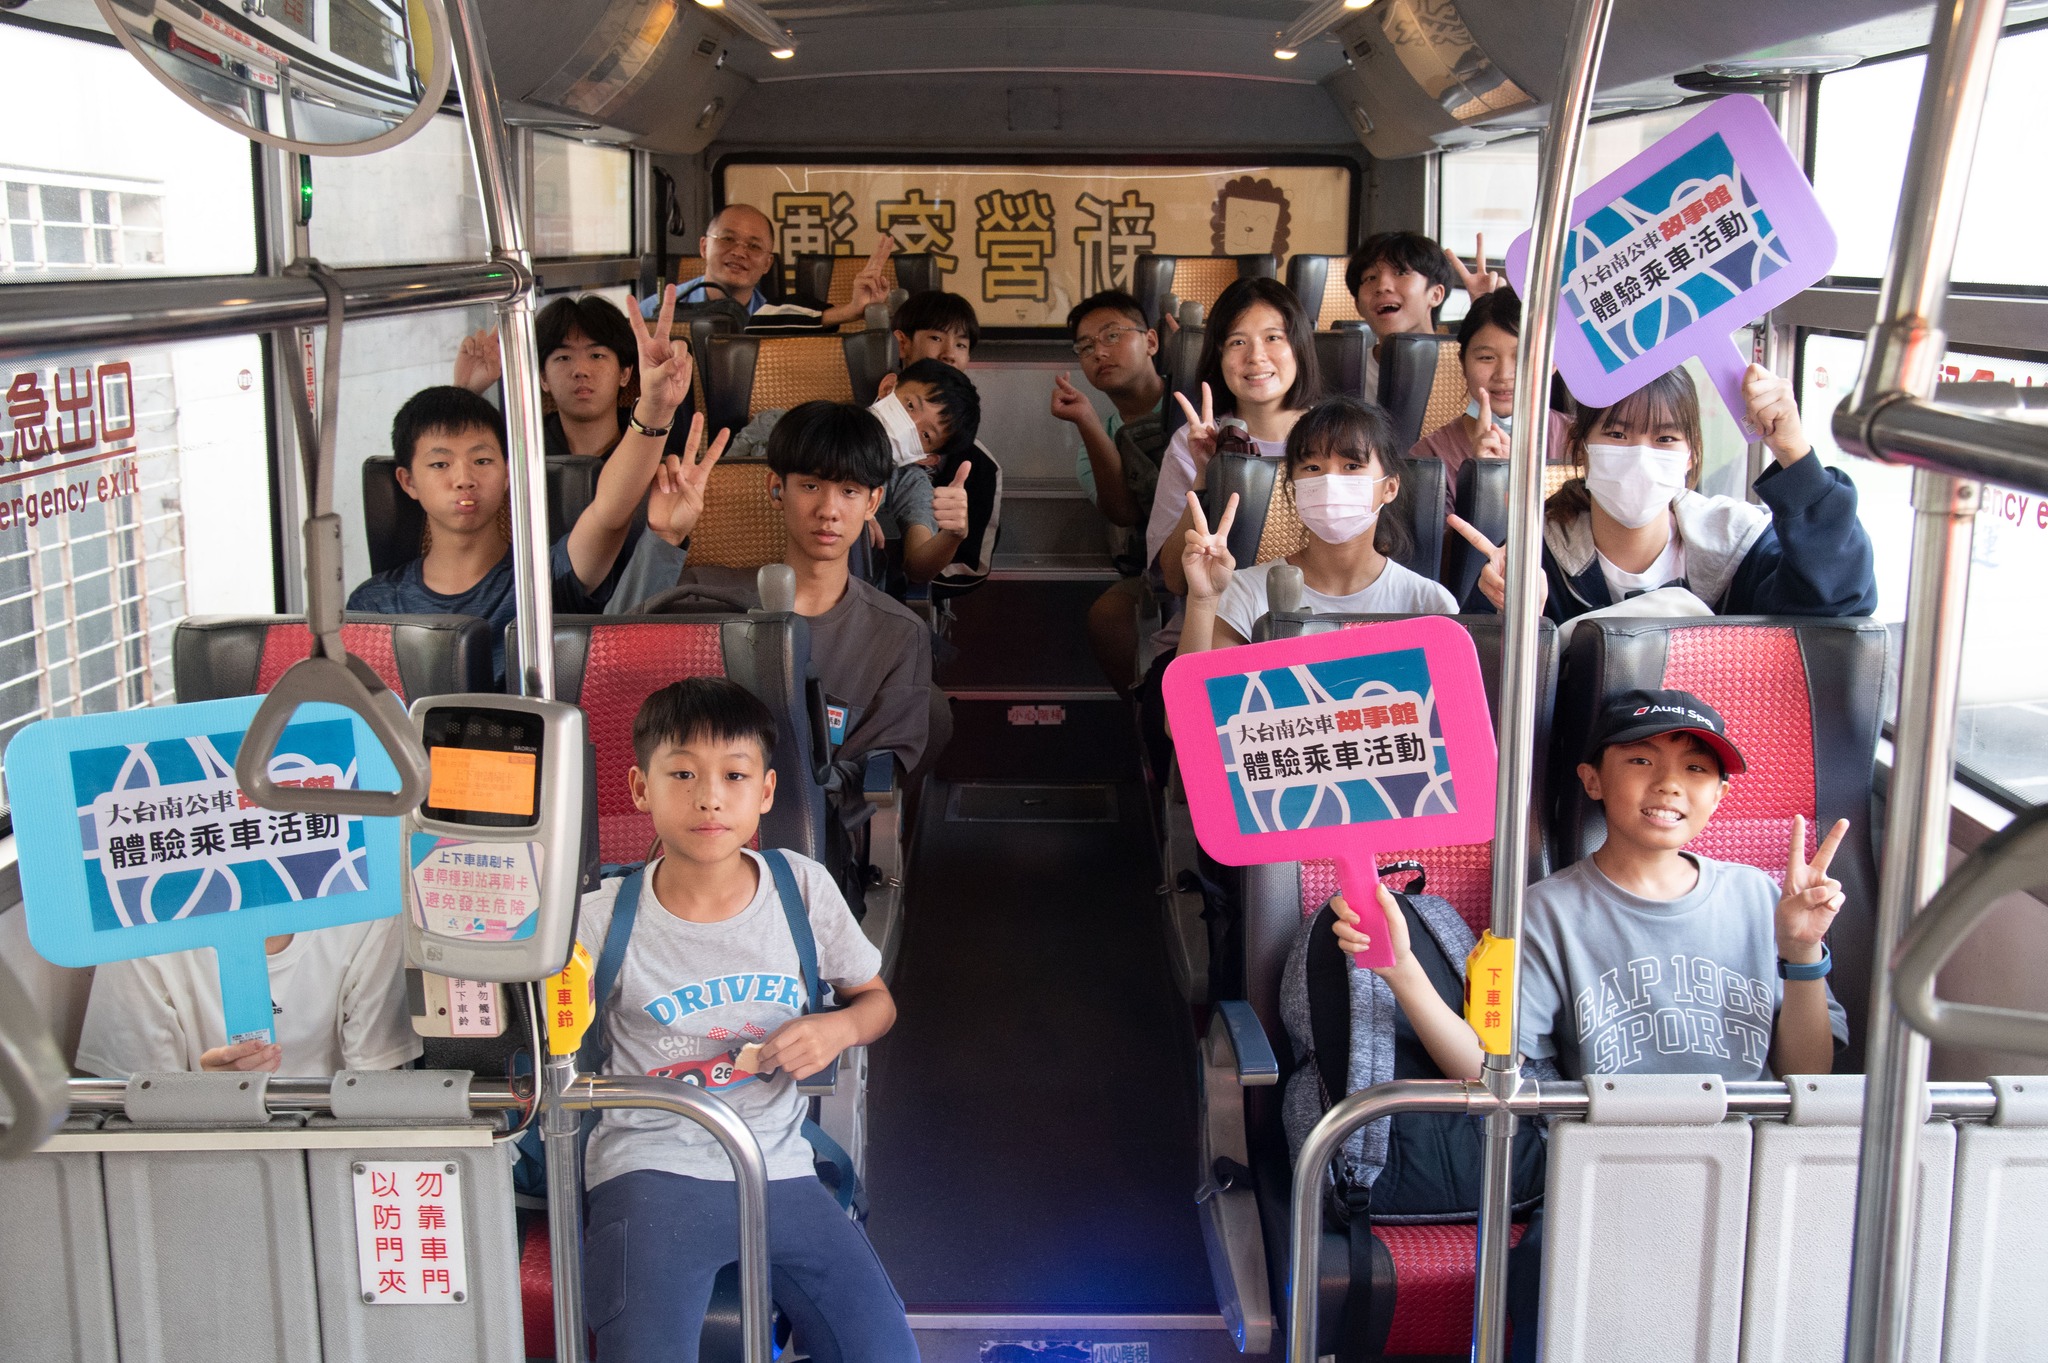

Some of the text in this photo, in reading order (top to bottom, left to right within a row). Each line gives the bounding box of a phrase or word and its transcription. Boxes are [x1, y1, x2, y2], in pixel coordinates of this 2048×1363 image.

[1579, 184, 1733, 294] 大台南公車故事館
[1590, 210, 1748, 323] 體驗乘車活動
[0, 362, 135, 466] 急出口
[97, 458, 139, 503] exit
[1237, 702, 1419, 745] 大台南公車故事館
[1650, 704, 1685, 715] Audi
[1243, 732, 1426, 781] 體驗乘車活動
[109, 812, 340, 869] 體驗乘車活動
[438, 851, 515, 869] 上下車請刷卡
[423, 867, 529, 891] 車停穩到站再刷卡
[425, 892, 526, 916] 避免發生危險
[557, 967, 574, 1028] 下車鈴
[642, 972, 800, 1026] DRIVER
[1485, 968, 1502, 1028] 下車鈴
[1575, 956, 1661, 1044] GAP
[1594, 1008, 1769, 1074] SPORT
[714, 1067, 733, 1079] 26
[371, 1171, 406, 1294] 以防門夾
[415, 1171, 450, 1294] 勿靠車門
